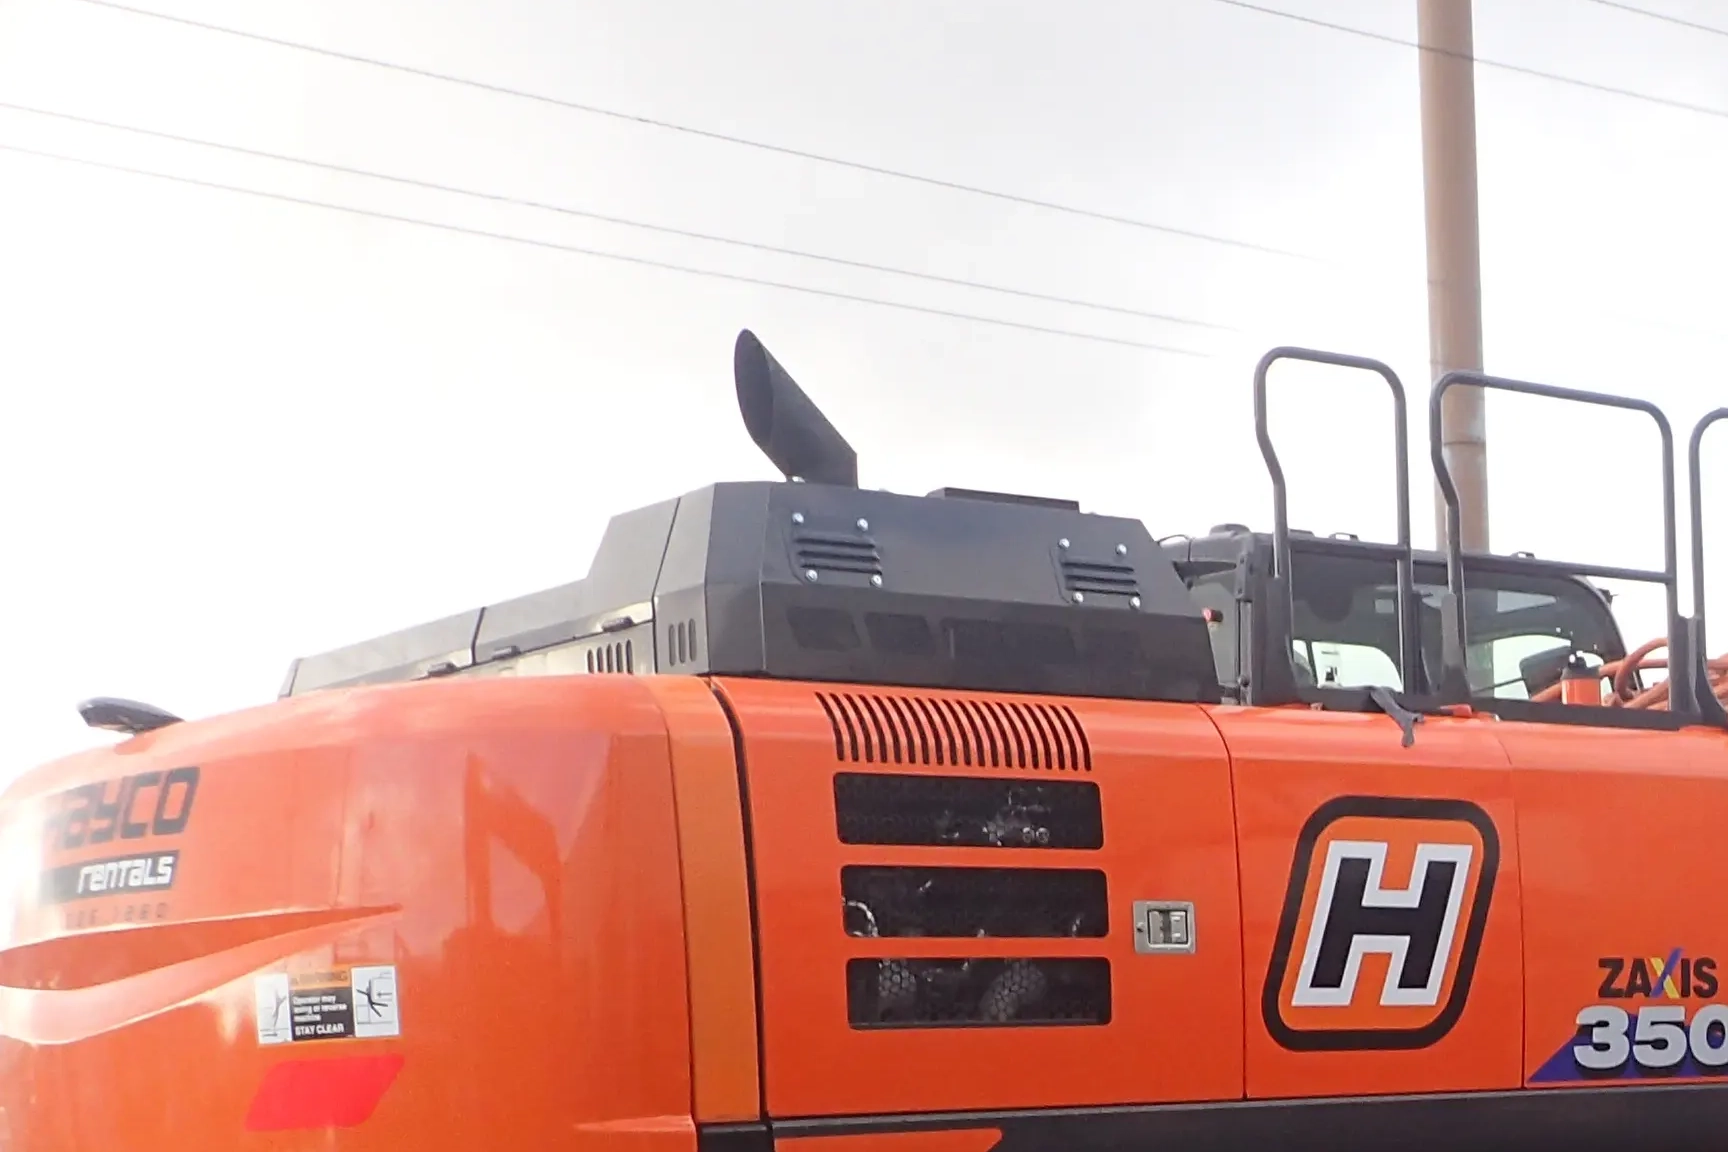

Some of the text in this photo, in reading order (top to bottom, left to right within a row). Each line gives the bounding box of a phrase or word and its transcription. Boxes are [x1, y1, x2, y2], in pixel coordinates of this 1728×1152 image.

[1292, 840, 1473, 1006] H
[1598, 947, 1720, 998] ZAXIS
[295, 1023, 344, 1035] STAY CLEAR
